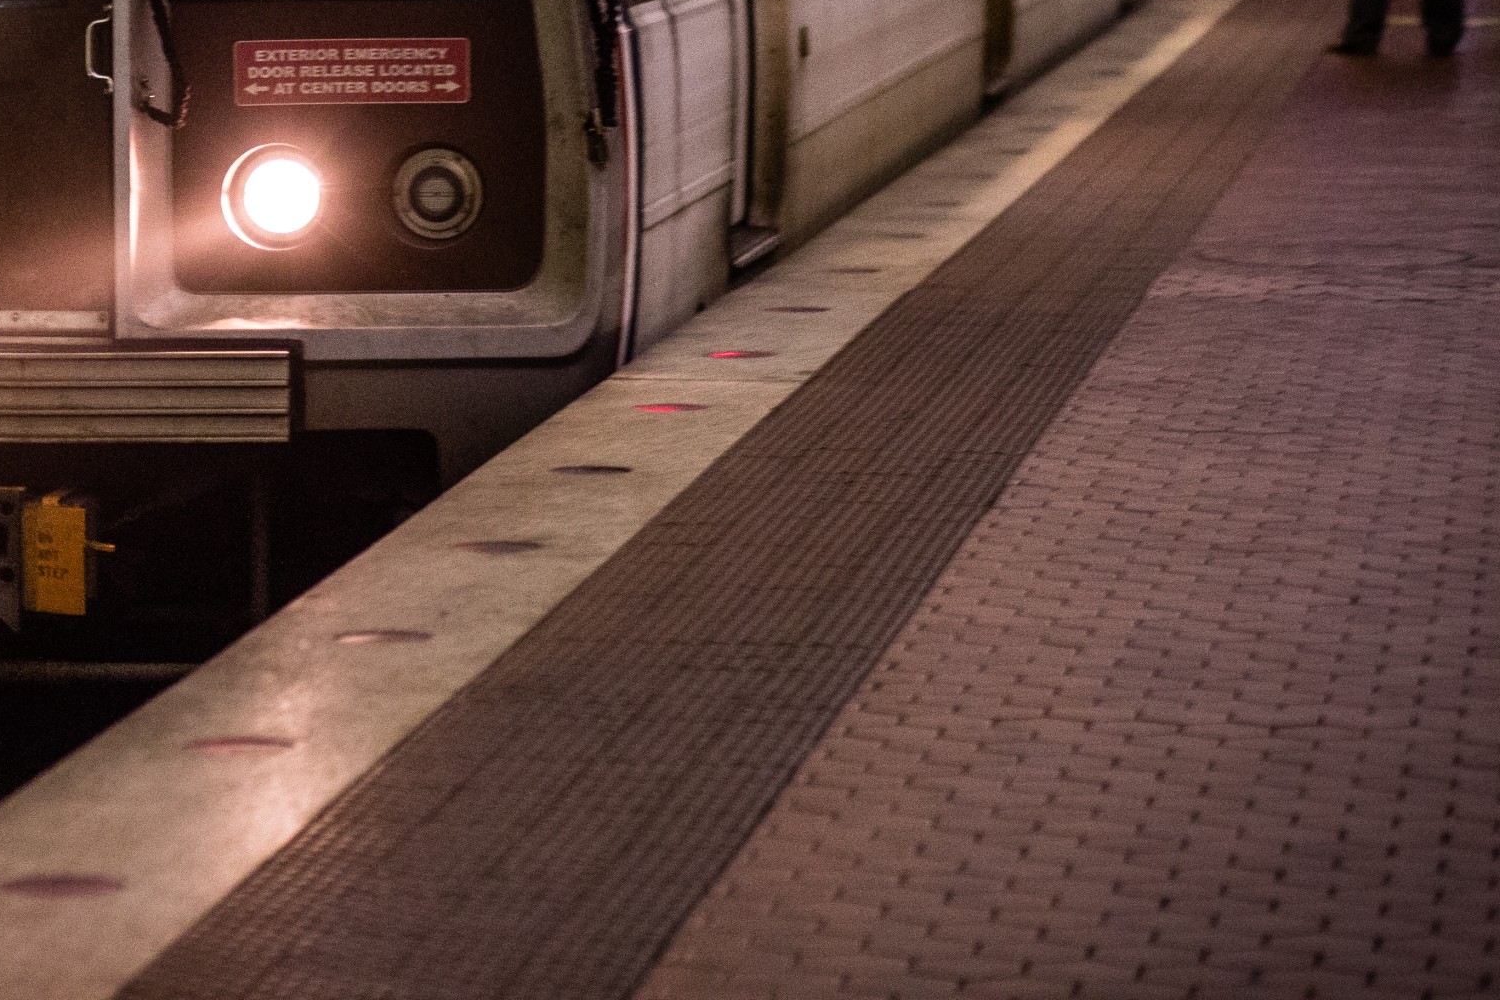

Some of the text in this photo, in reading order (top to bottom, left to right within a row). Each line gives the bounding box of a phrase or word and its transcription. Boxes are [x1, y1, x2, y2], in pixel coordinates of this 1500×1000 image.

[254, 47, 449, 62] EXTERIOR EMERGENCY
[247, 63, 457, 79] DOOR RELEASE LOCATED
[273, 81, 430, 95] AT CENTER DOORS
